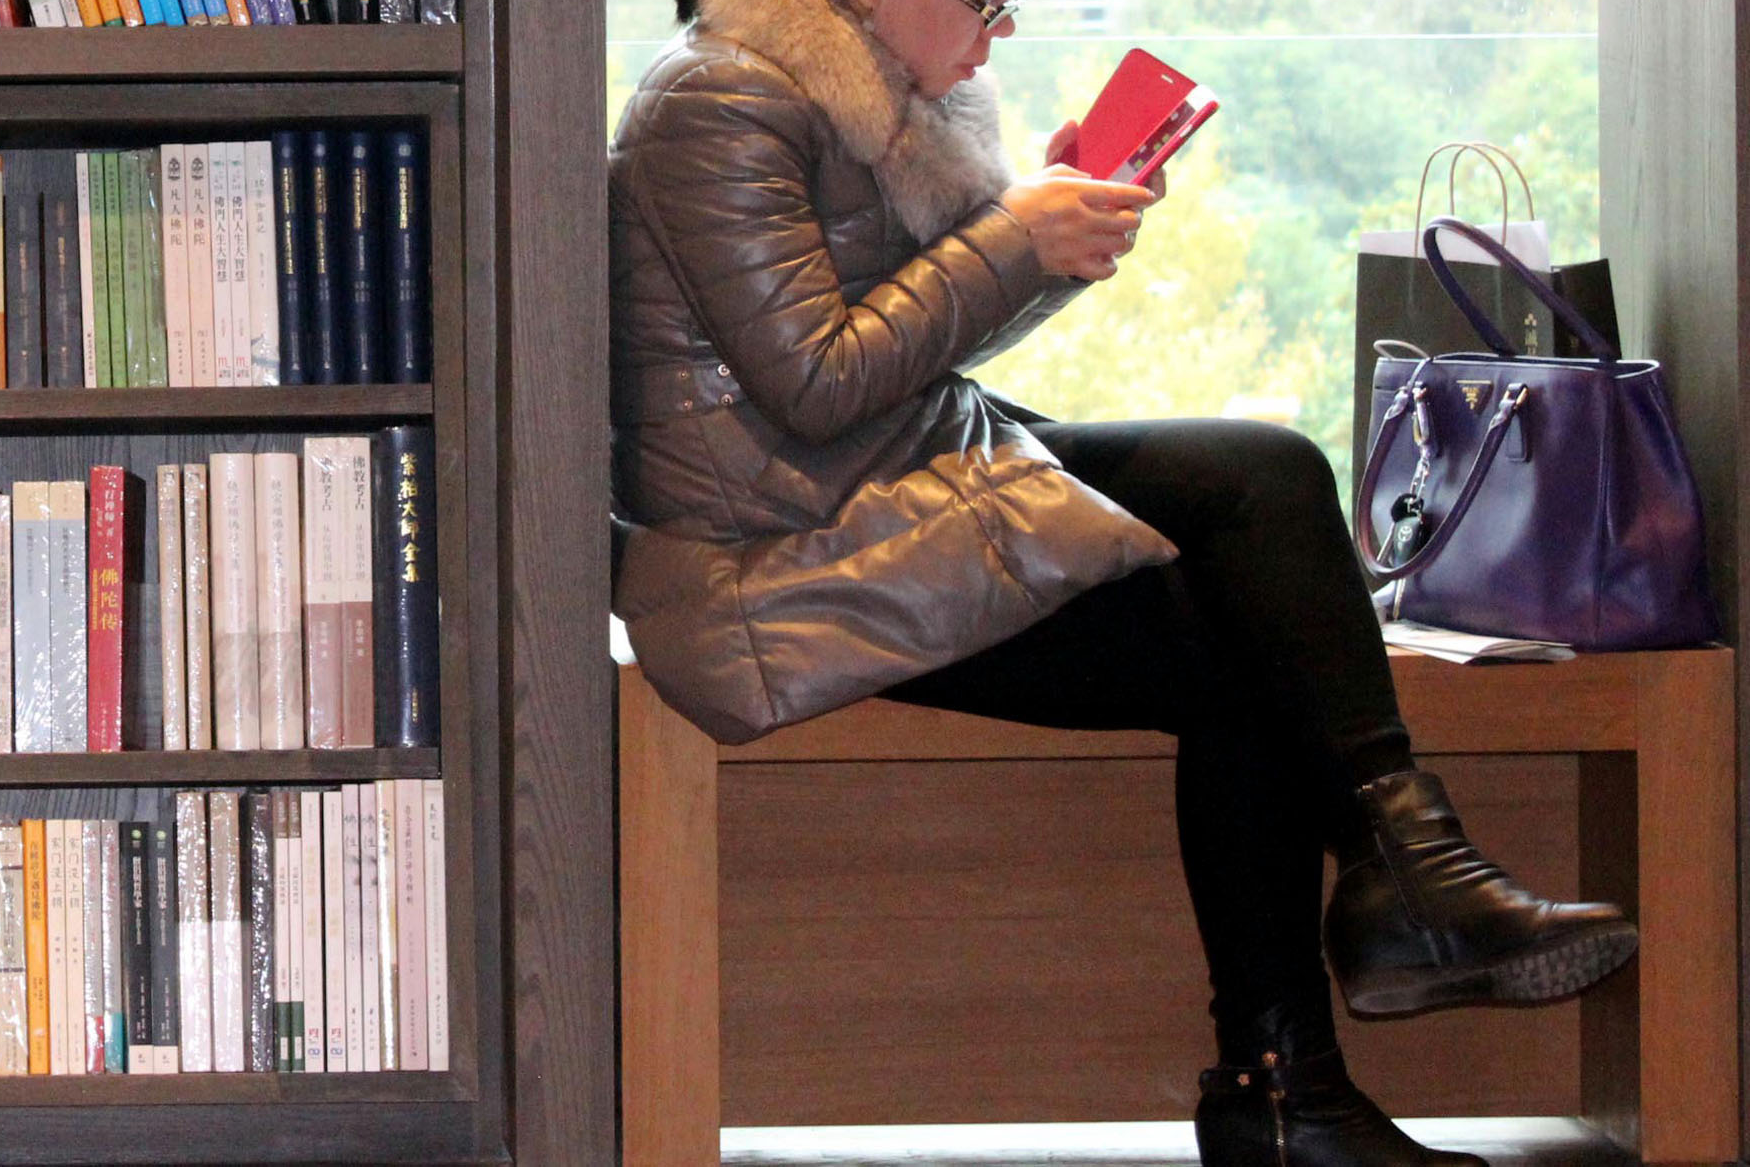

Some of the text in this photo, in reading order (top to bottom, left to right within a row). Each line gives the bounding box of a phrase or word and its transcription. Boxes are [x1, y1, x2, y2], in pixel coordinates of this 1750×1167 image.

[352, 455, 366, 512] 佛教考古
[100, 568, 119, 631] 佛陀传
